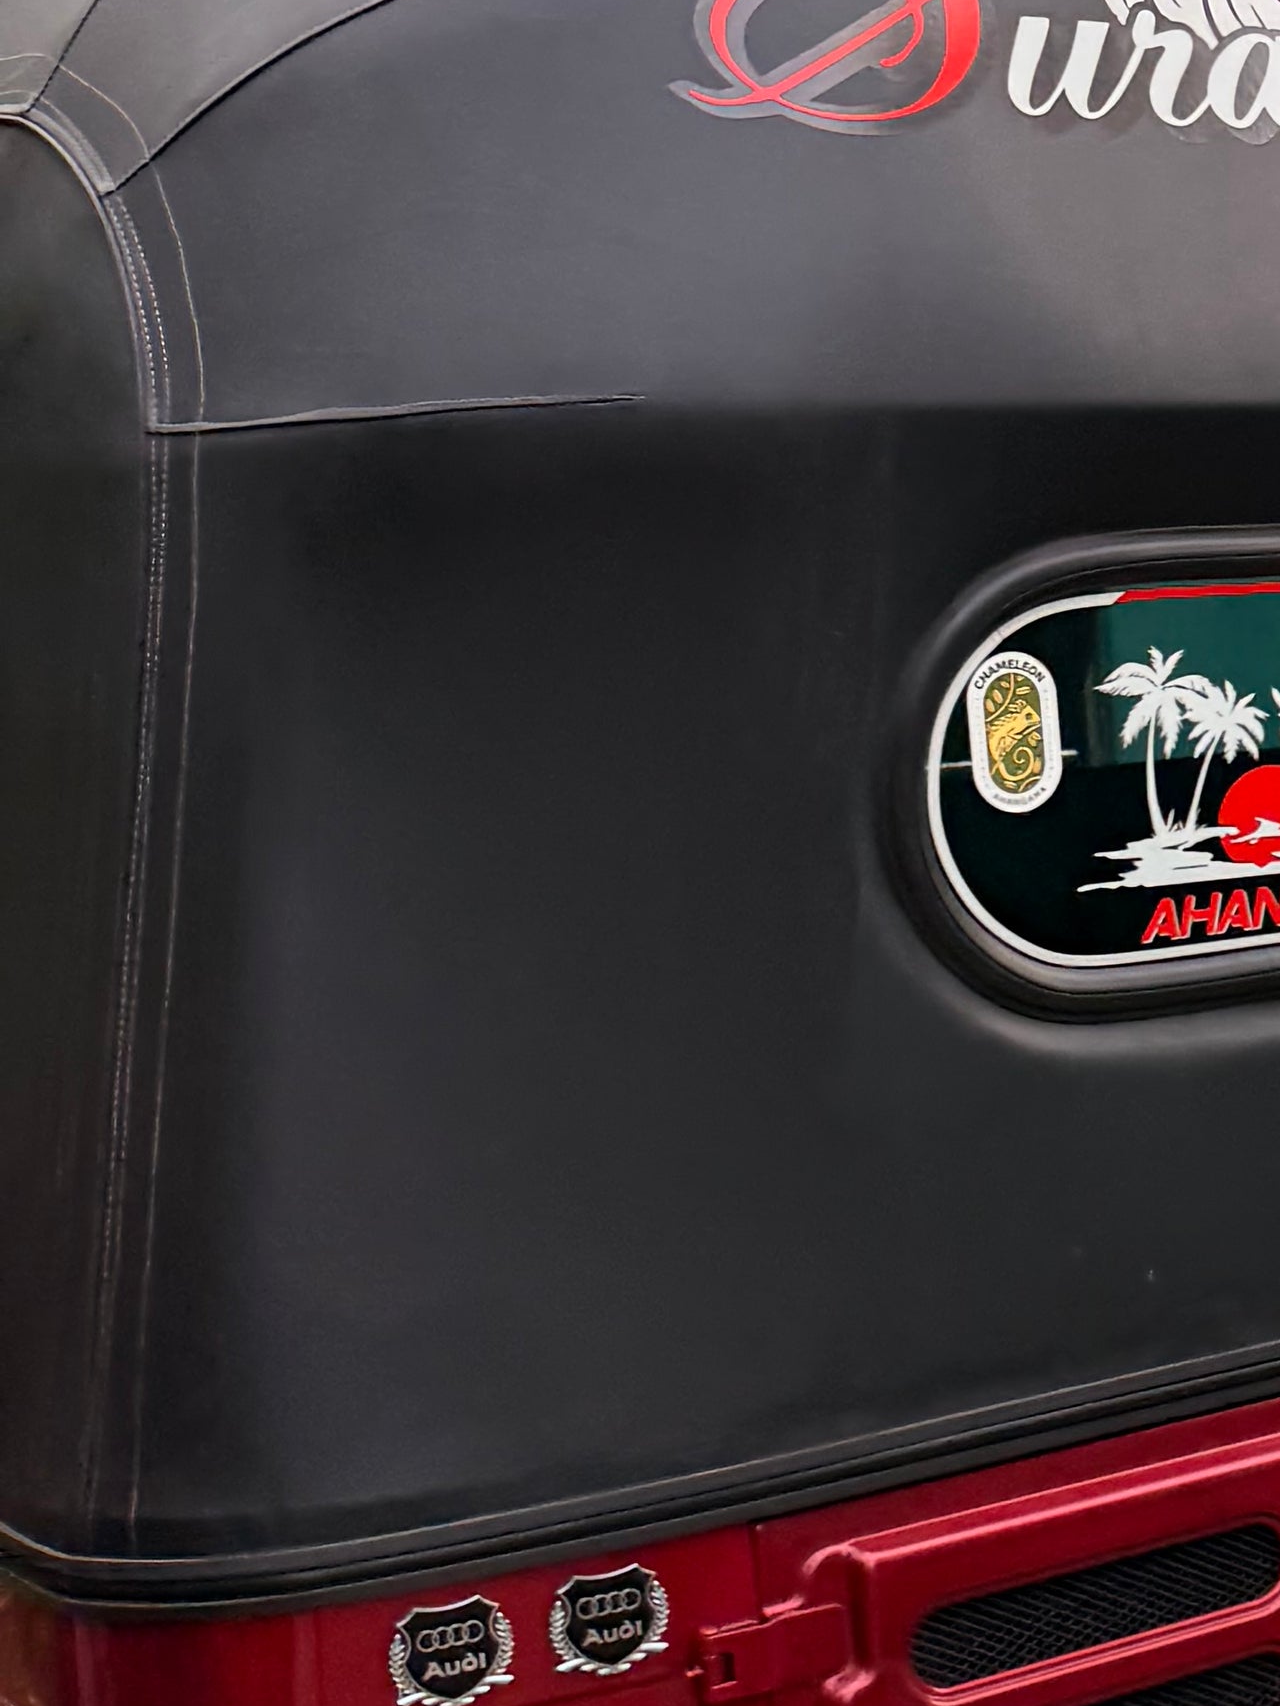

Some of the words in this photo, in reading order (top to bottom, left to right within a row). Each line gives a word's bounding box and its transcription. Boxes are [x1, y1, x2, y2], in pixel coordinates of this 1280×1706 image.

[973, 659, 1046, 690] CHAMELEON
[580, 1619, 643, 1648] Audi
[422, 1651, 487, 1681] Audi
